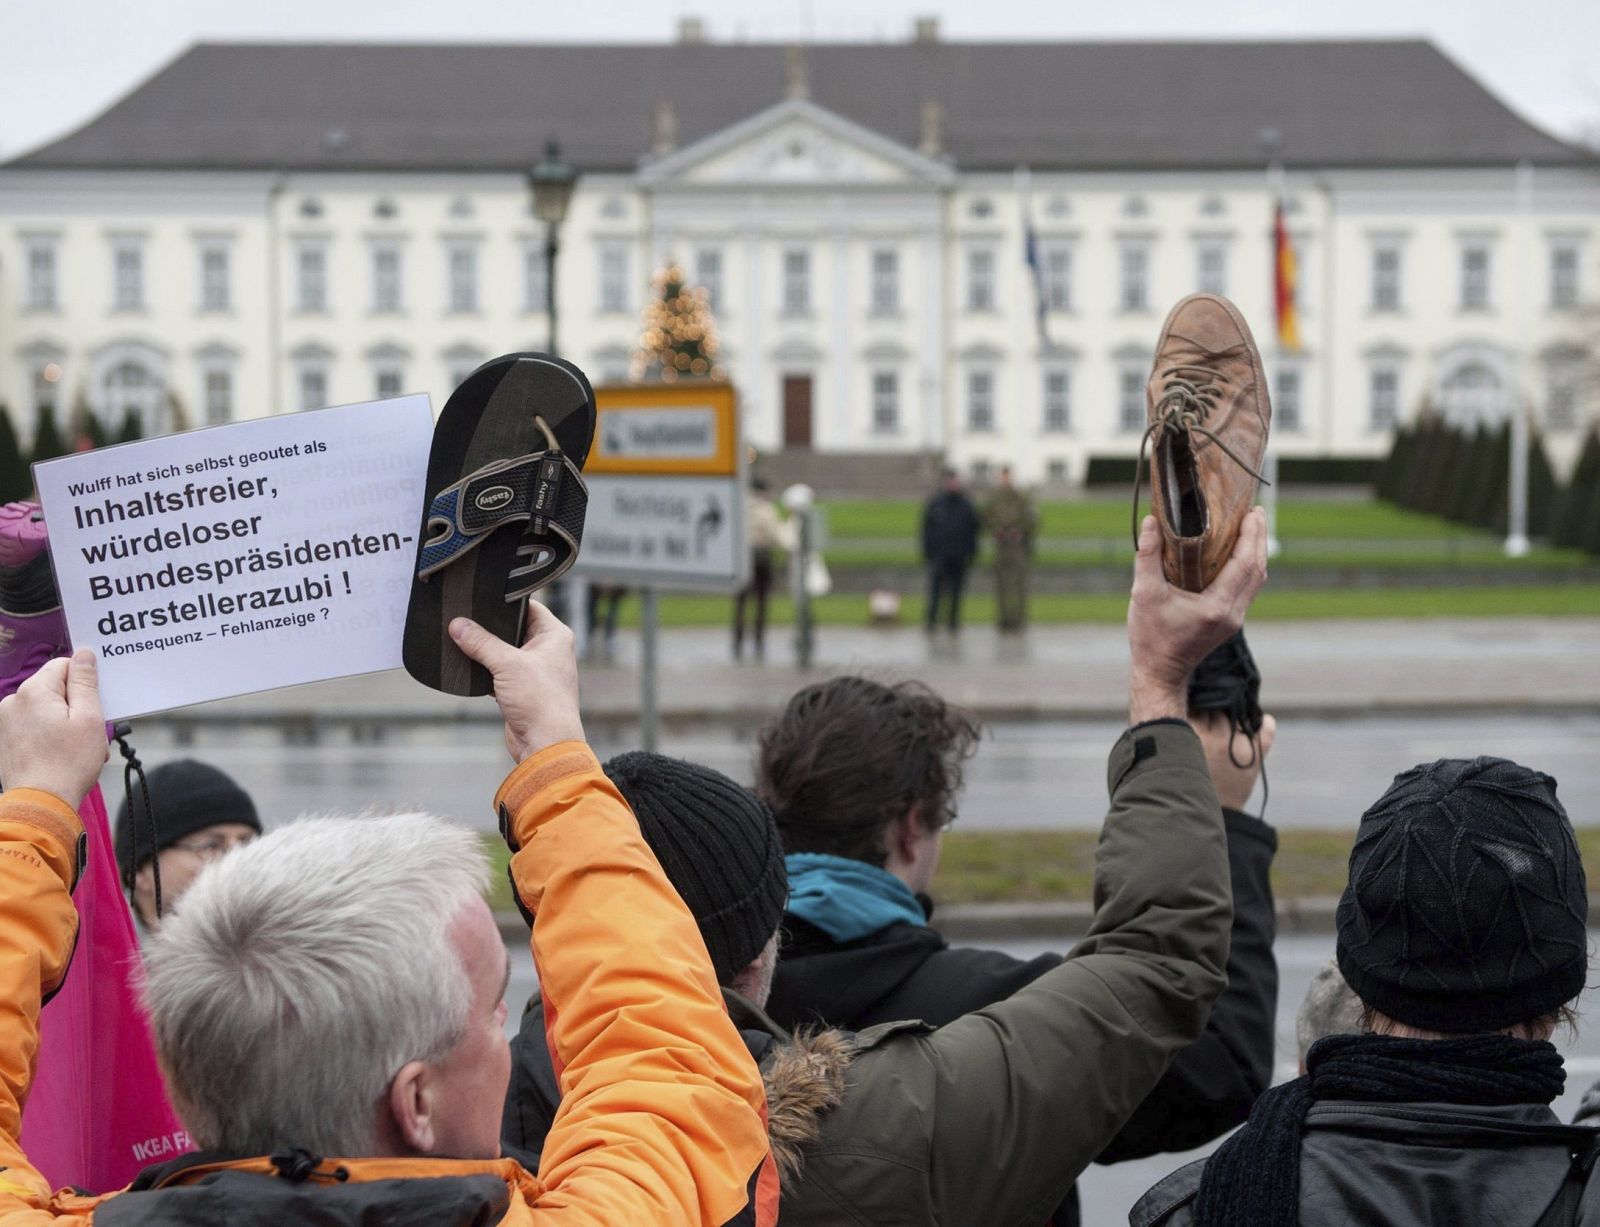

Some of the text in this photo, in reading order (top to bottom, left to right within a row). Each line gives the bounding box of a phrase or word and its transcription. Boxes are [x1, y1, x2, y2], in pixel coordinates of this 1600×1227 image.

[67, 476, 113, 497] Wulff
[115, 471, 143, 488] hat
[147, 464, 181, 483] sich
[185, 457, 235, 475] selbst
[238, 443, 301, 469] geoutet
[303, 439, 328, 456] als
[73, 476, 279, 530] Inhaltsfreier,
[480, 491, 511, 505] fashy
[536, 481, 549, 510] fashy
[80, 515, 263, 566] würdeloser
[88, 532, 414, 601] Bundespräsidenten-
[97, 573, 334, 636] darstellerazubi
[101, 631, 205, 658] Konsequenz
[220, 612, 317, 637] Fehlanzeige
[132, 1134, 174, 1162] IKEA
